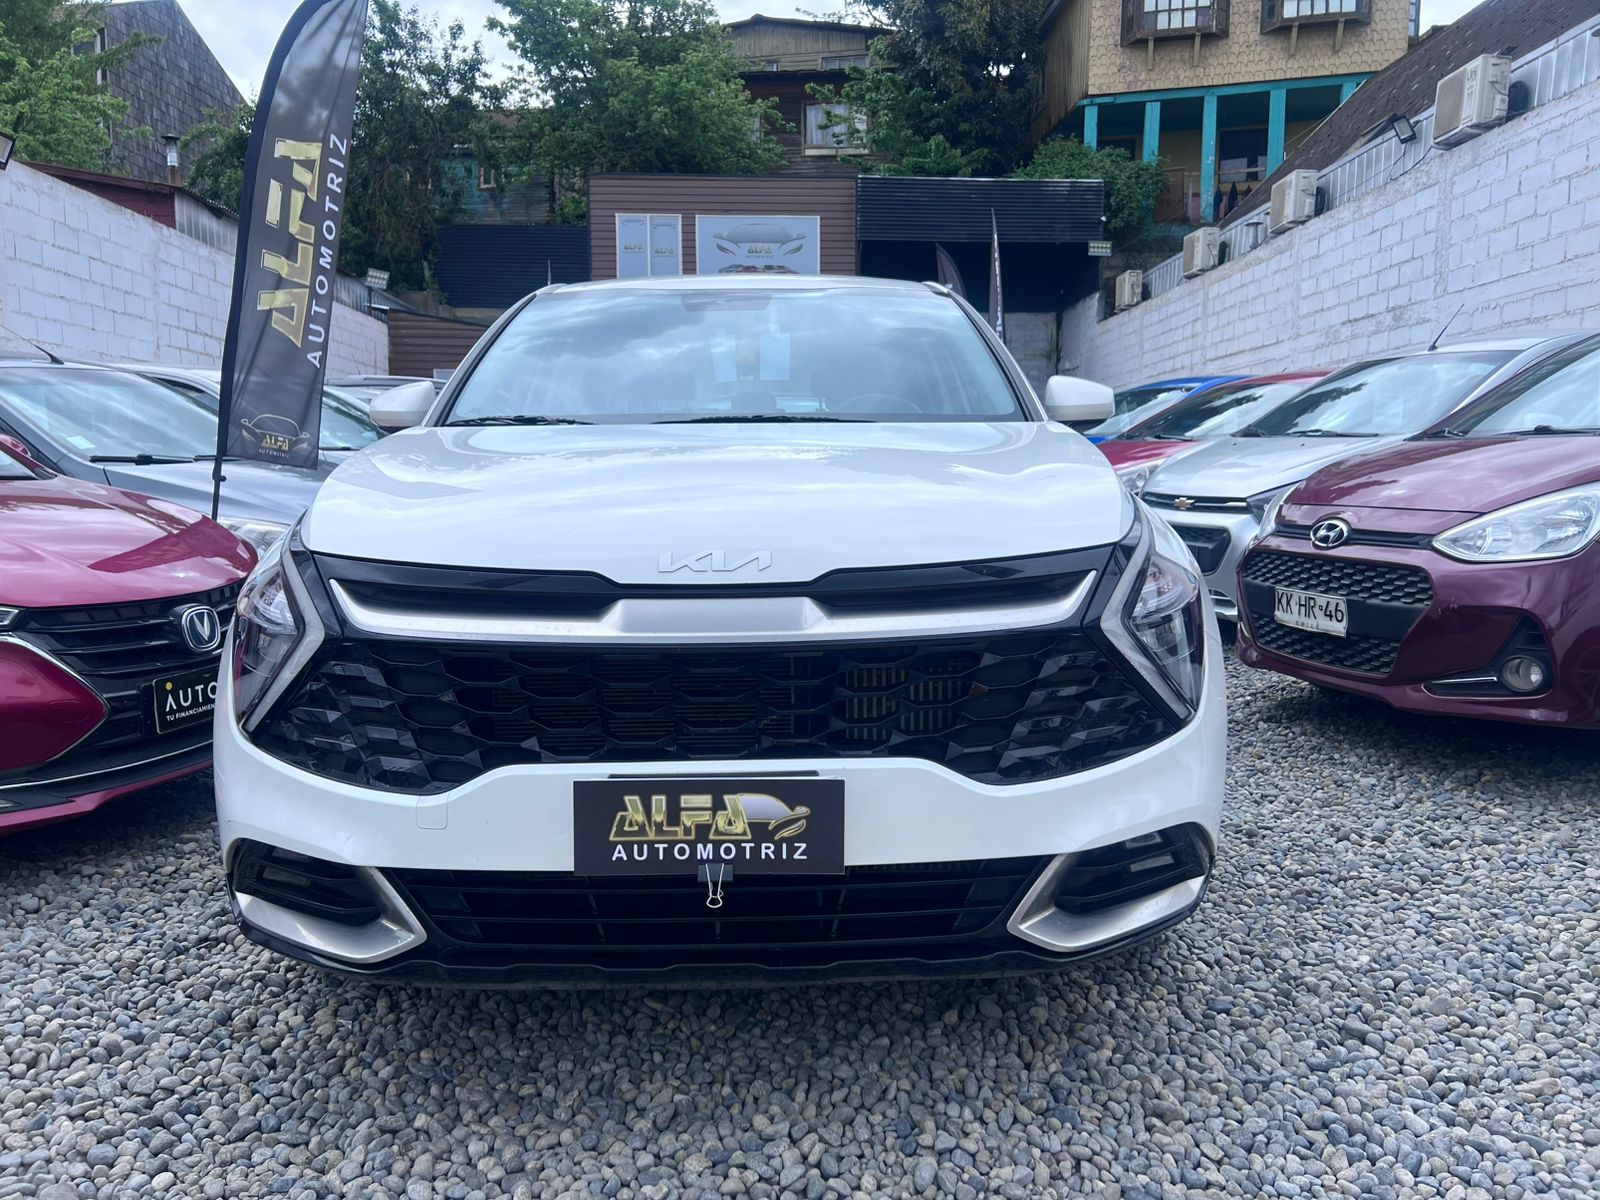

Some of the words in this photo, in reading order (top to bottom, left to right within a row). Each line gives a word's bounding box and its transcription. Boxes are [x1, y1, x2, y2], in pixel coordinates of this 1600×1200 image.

[257, 137, 323, 348] ALFA
[307, 134, 347, 369] AUTOMOTRIZ
[261, 434, 289, 451] ALFA
[166, 713, 175, 721] TU
[609, 795, 751, 841] ALFA
[612, 843, 807, 860] AUTOMOTRIZ
